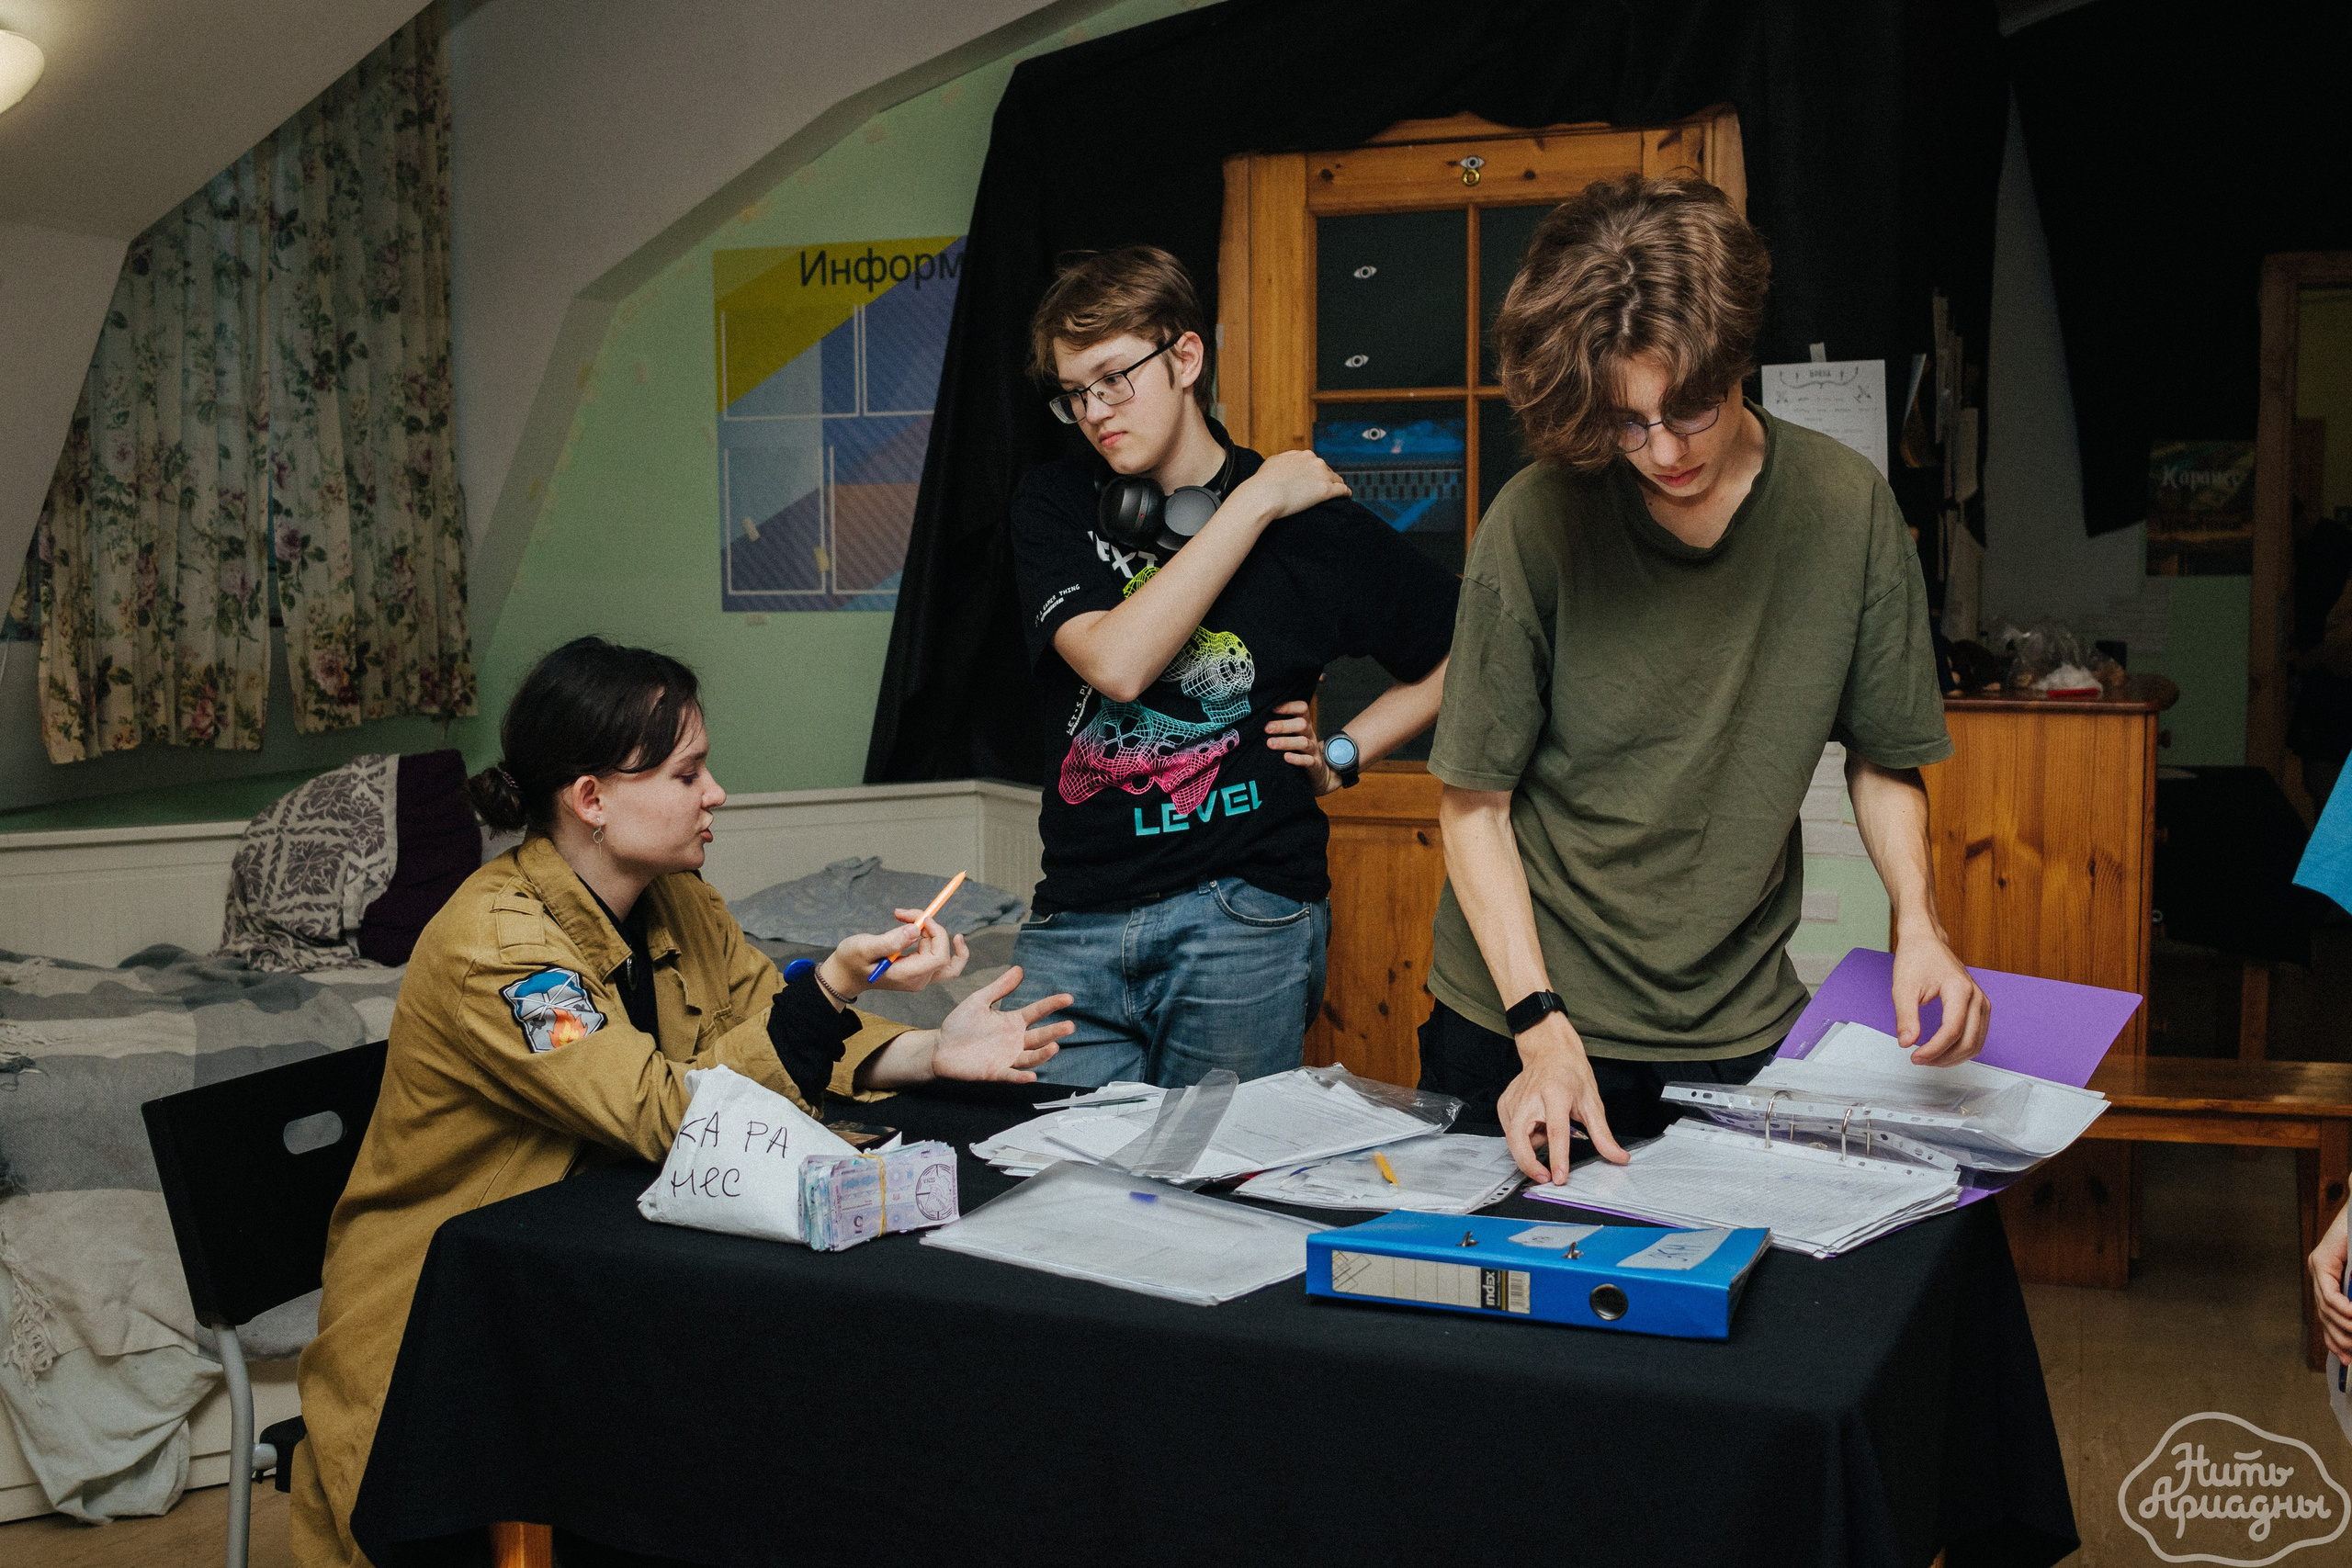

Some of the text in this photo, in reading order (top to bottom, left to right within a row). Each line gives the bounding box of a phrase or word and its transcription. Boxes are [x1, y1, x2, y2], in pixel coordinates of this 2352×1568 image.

[800, 248, 965, 292] Информ
[1087, 530, 1159, 579] EXT
[1058, 583, 1080, 596] THING
[1079, 683, 1090, 695] PL
[1134, 780, 1263, 836] LEVEL
[677, 1111, 788, 1158] КА РА
[1482, 1270, 1496, 1306] index
